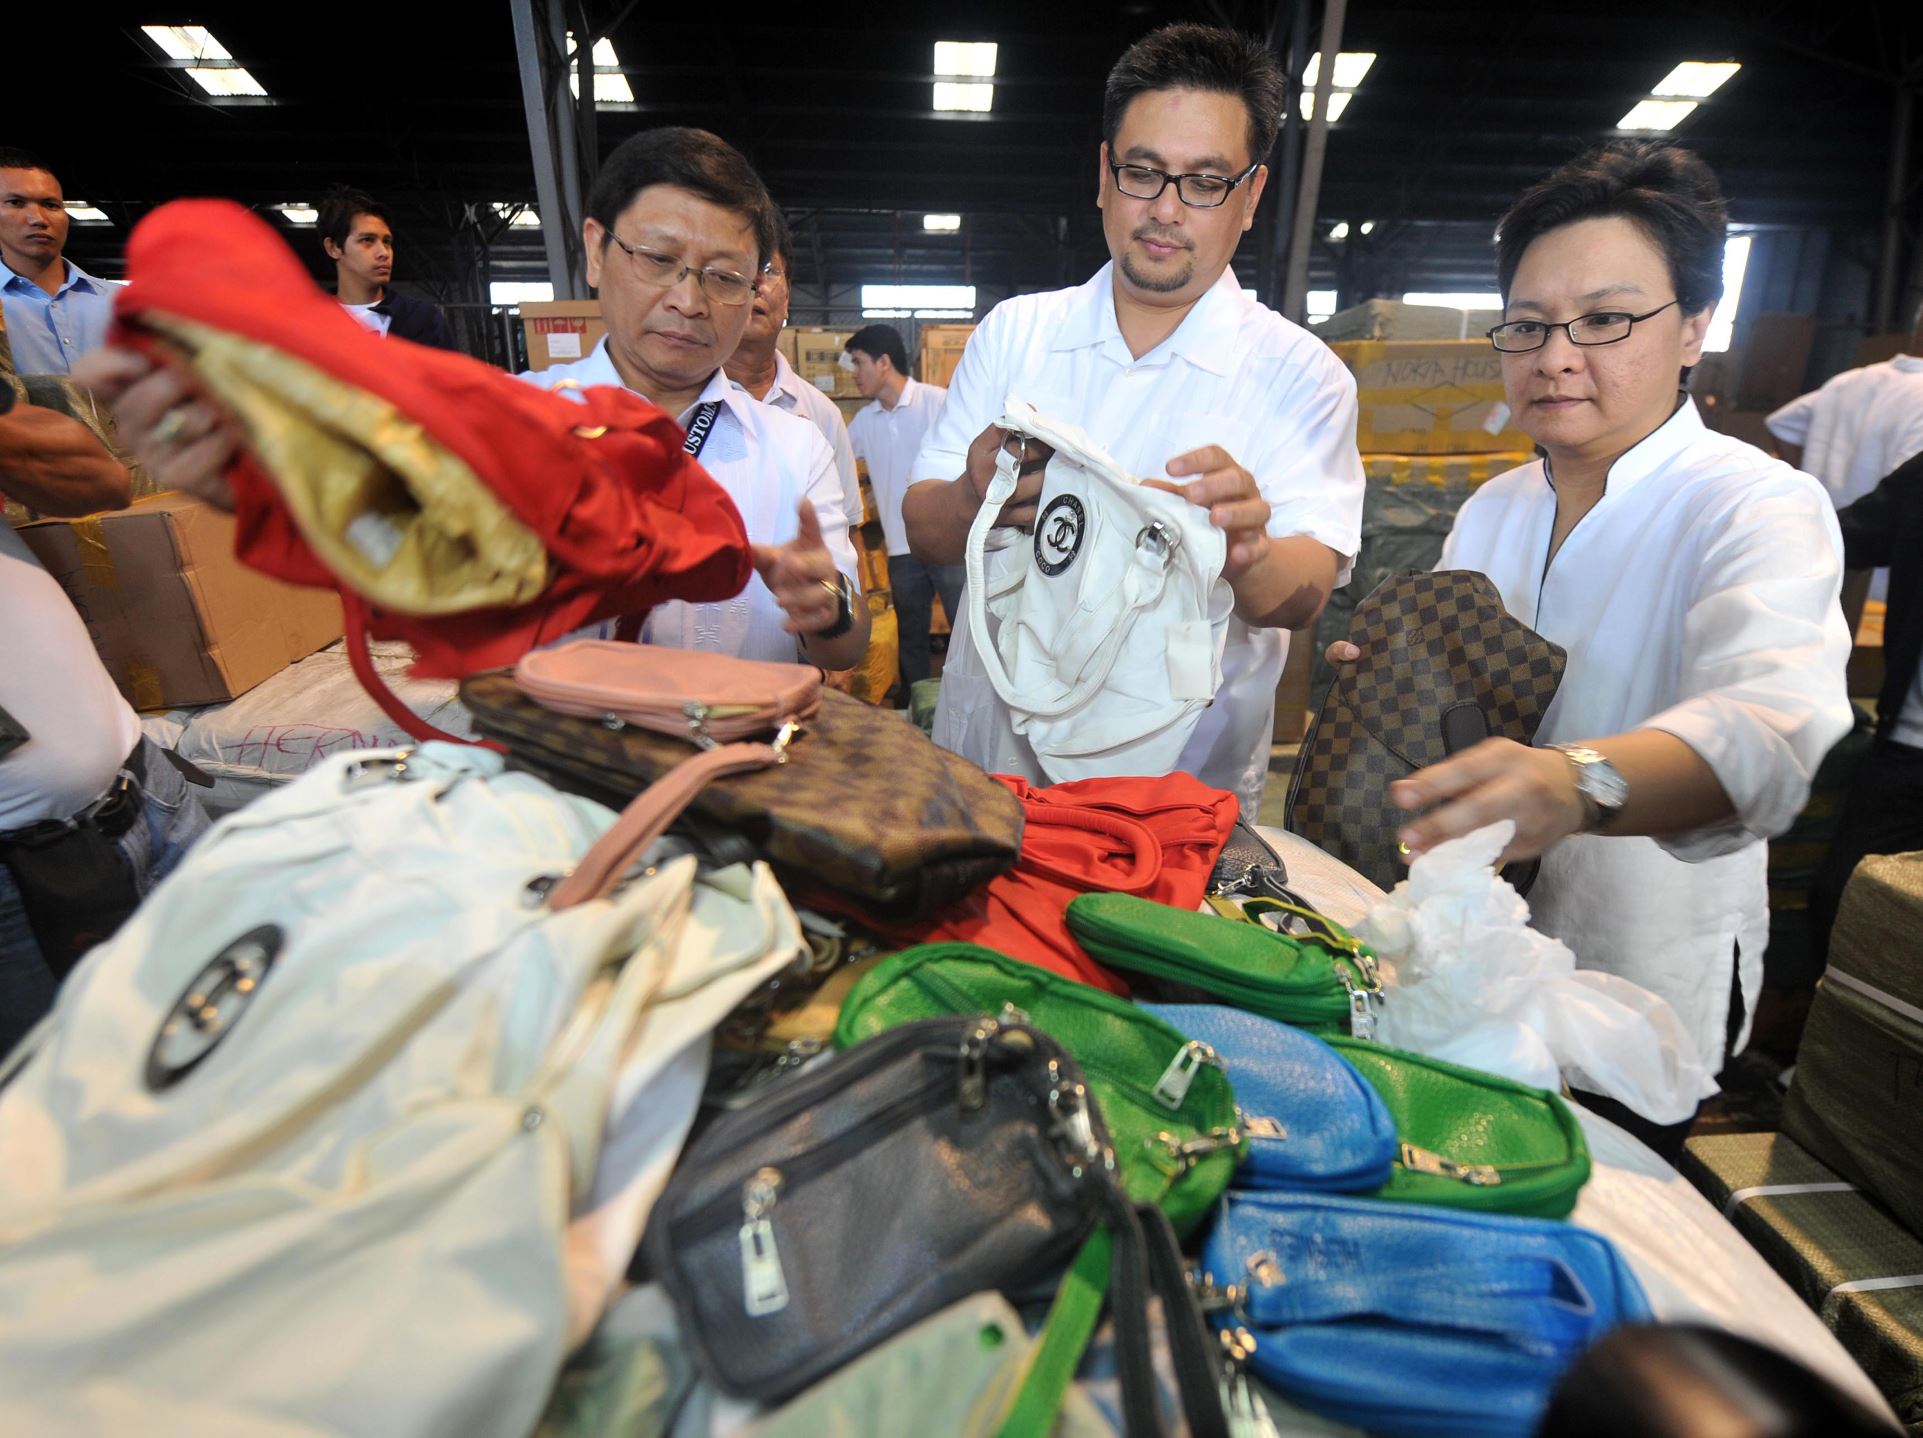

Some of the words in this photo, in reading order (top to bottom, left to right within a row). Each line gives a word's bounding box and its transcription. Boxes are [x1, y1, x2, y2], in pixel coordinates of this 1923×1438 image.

[682, 401, 717, 455] USTOMS
[1062, 495, 1084, 529] CHANEL
[1035, 550, 1051, 572] COCO
